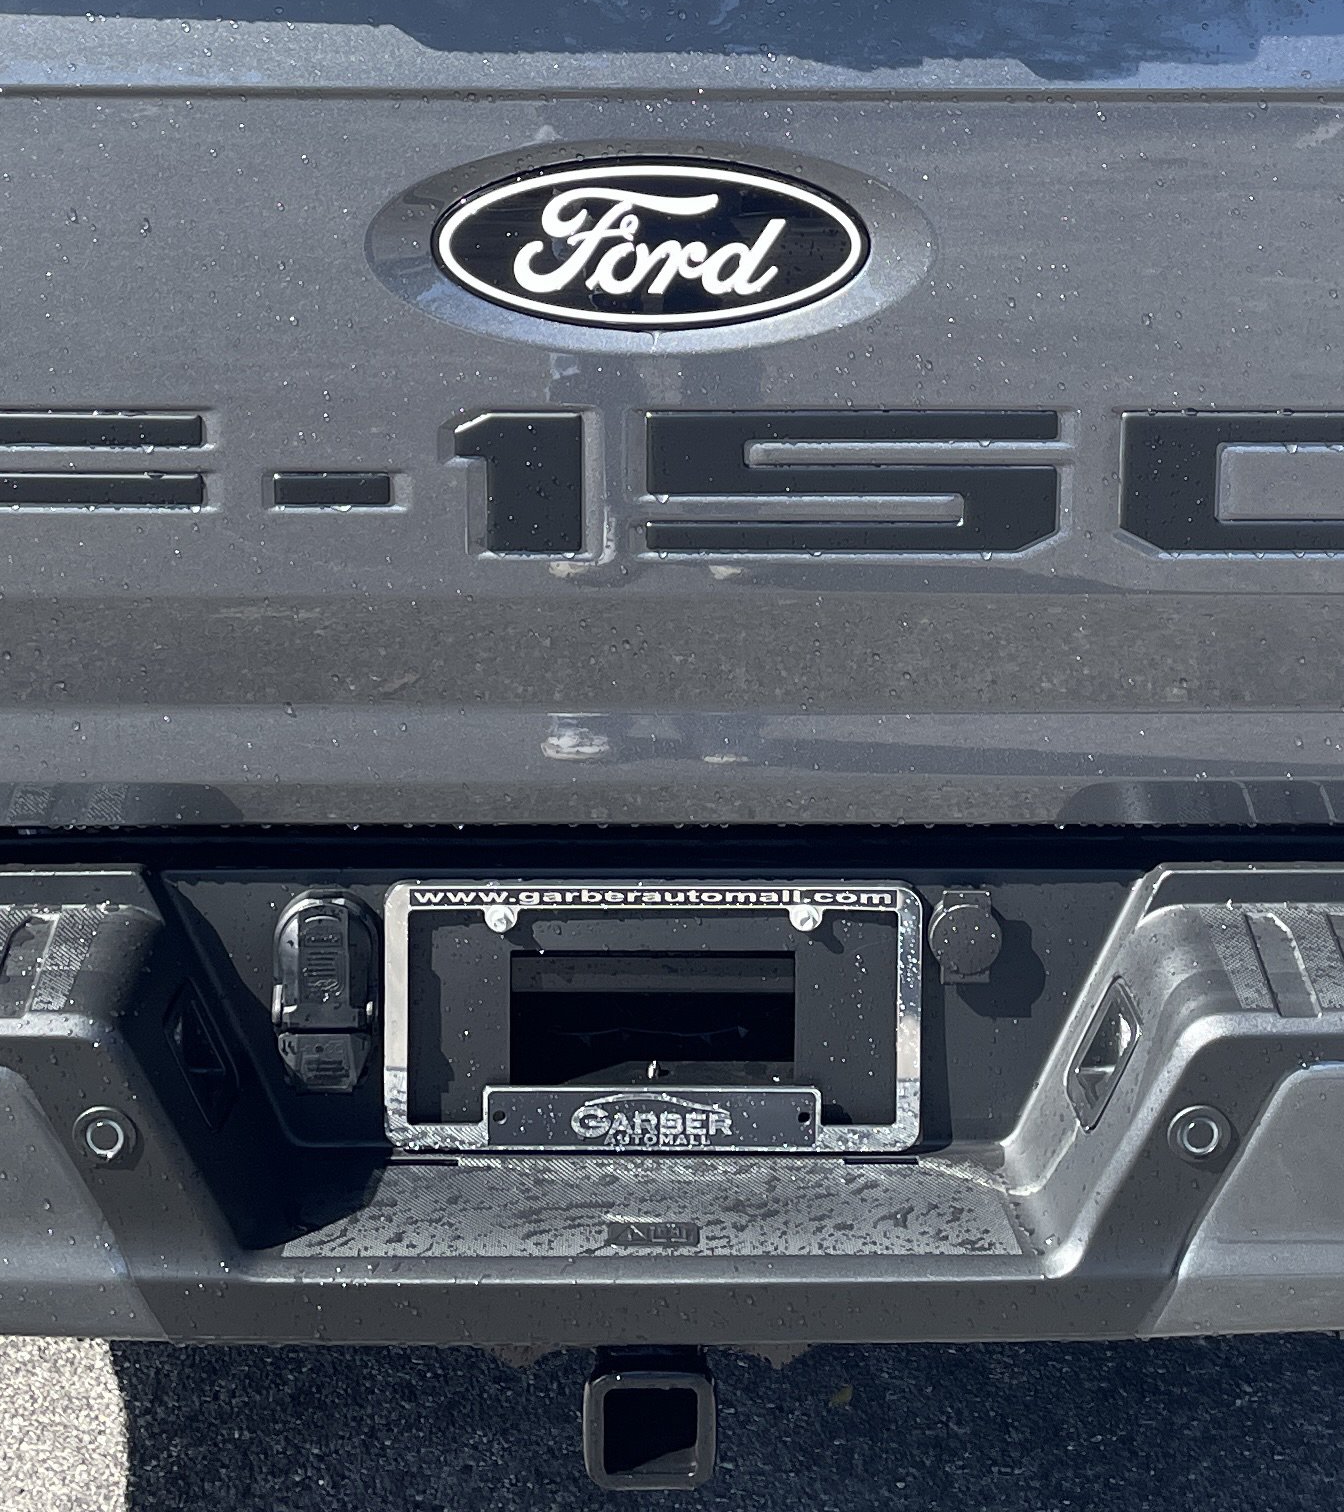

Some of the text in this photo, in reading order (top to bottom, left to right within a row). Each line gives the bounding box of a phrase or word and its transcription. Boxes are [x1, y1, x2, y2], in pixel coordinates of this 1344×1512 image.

[513, 187, 786, 295] Ford
[412, 888, 894, 907] www.garberautomall.com
[570, 1105, 734, 1138] GARBER
[603, 1134, 712, 1146] AUTOMALL
